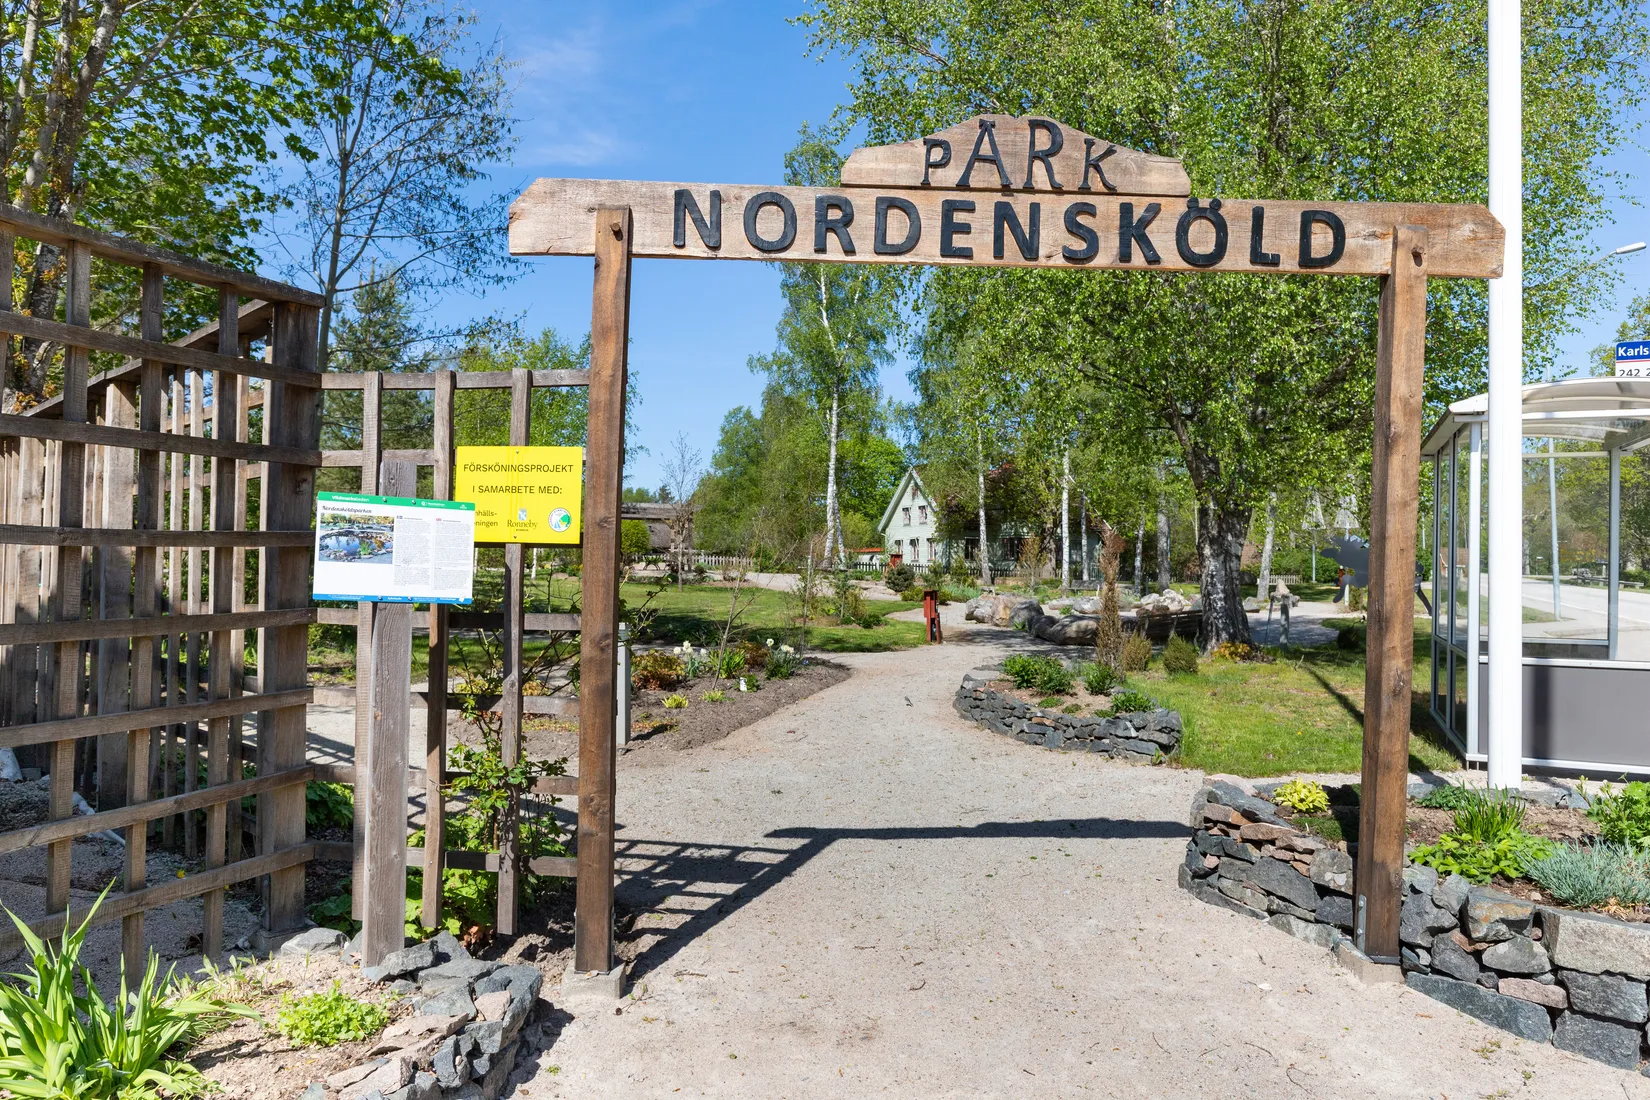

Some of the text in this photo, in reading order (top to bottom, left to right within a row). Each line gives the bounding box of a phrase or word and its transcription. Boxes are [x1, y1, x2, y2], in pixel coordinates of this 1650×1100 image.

[920, 118, 1118, 192] PARK
[673, 188, 1346, 268] NORDENSKÖLD
[1619, 368, 1640, 377] 242
[463, 461, 574, 473] FÖRSKÖNINGSPROJEKT
[478, 485, 535, 494] SAMARBETE
[538, 485, 563, 494] MED:
[474, 520, 498, 528] ningen
[507, 518, 538, 531] Ronneby
